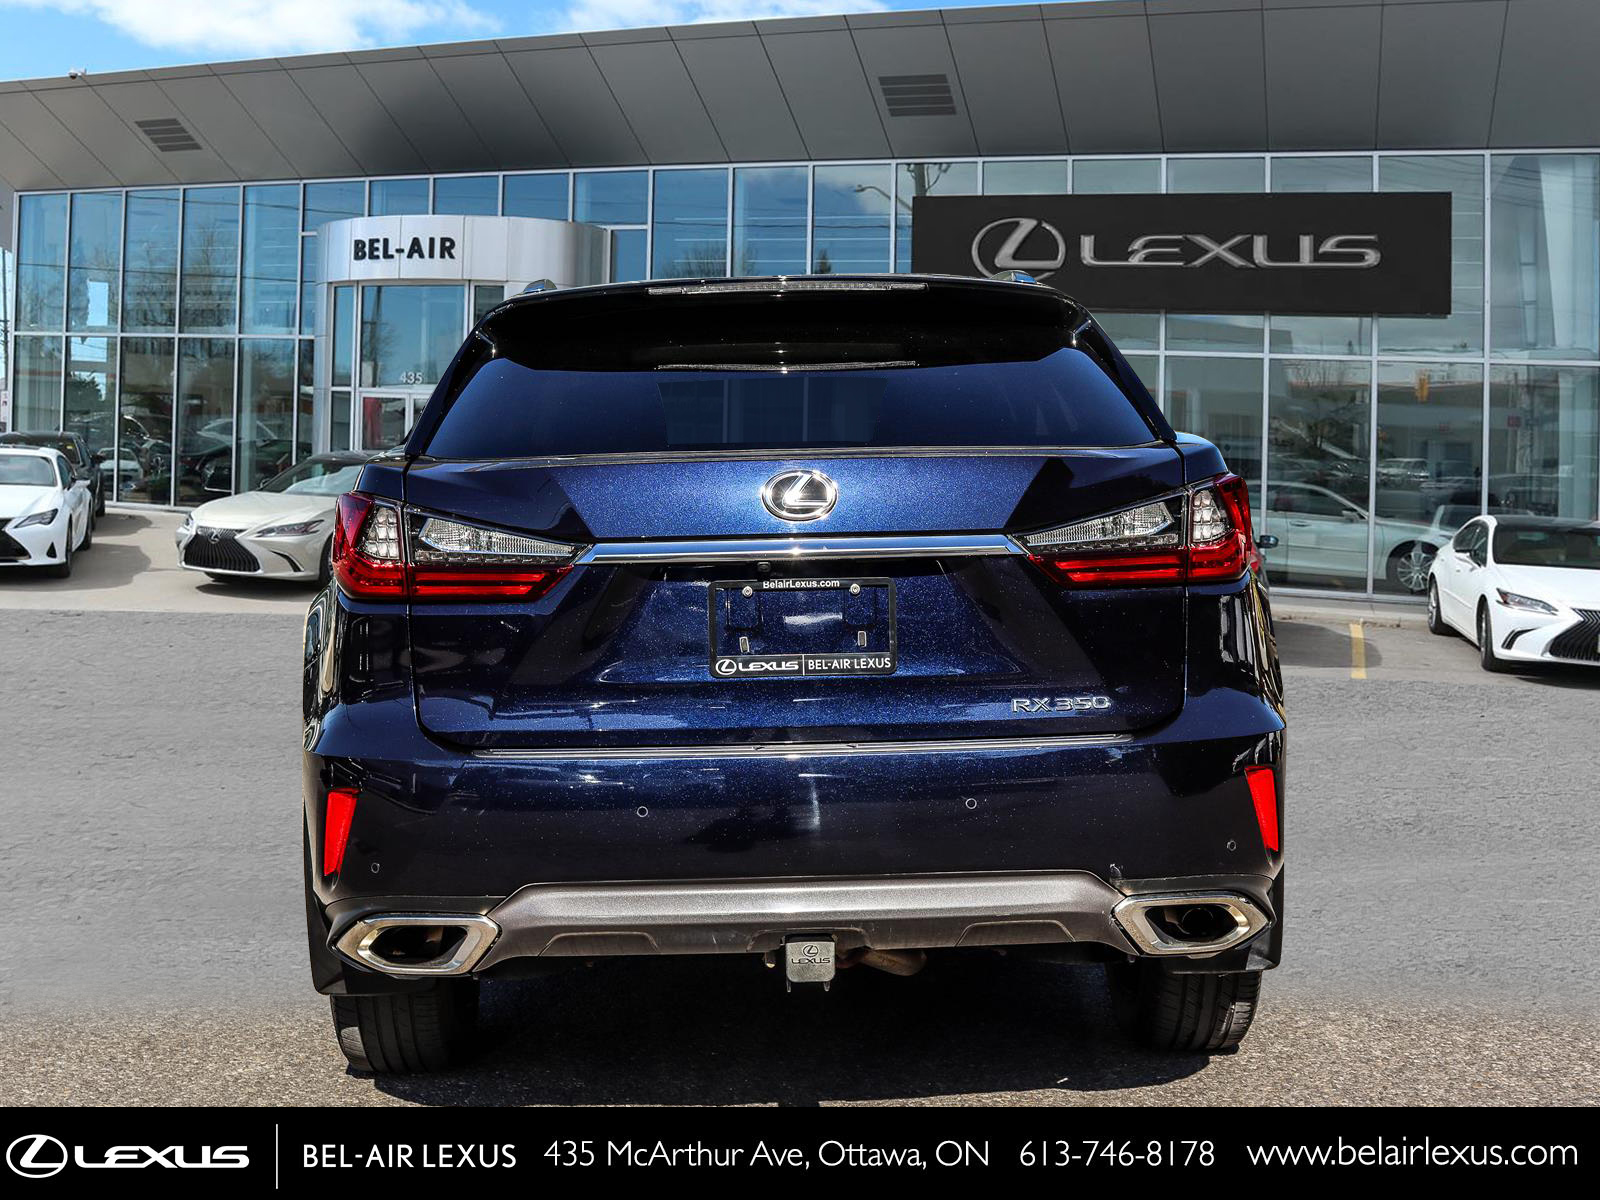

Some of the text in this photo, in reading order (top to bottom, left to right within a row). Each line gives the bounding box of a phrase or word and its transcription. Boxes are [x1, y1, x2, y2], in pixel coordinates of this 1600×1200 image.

[353, 236, 456, 261] BEL-AIR
[1080, 233, 1381, 269] LEXUS
[400, 371, 423, 384] 435
[763, 579, 840, 589] BelairLexus.com
[738, 660, 799, 672] LEXUS
[808, 657, 891, 671] BEL-AIR LEXUS
[1011, 696, 1112, 713] RX 350
[791, 957, 830, 965] LEXUS
